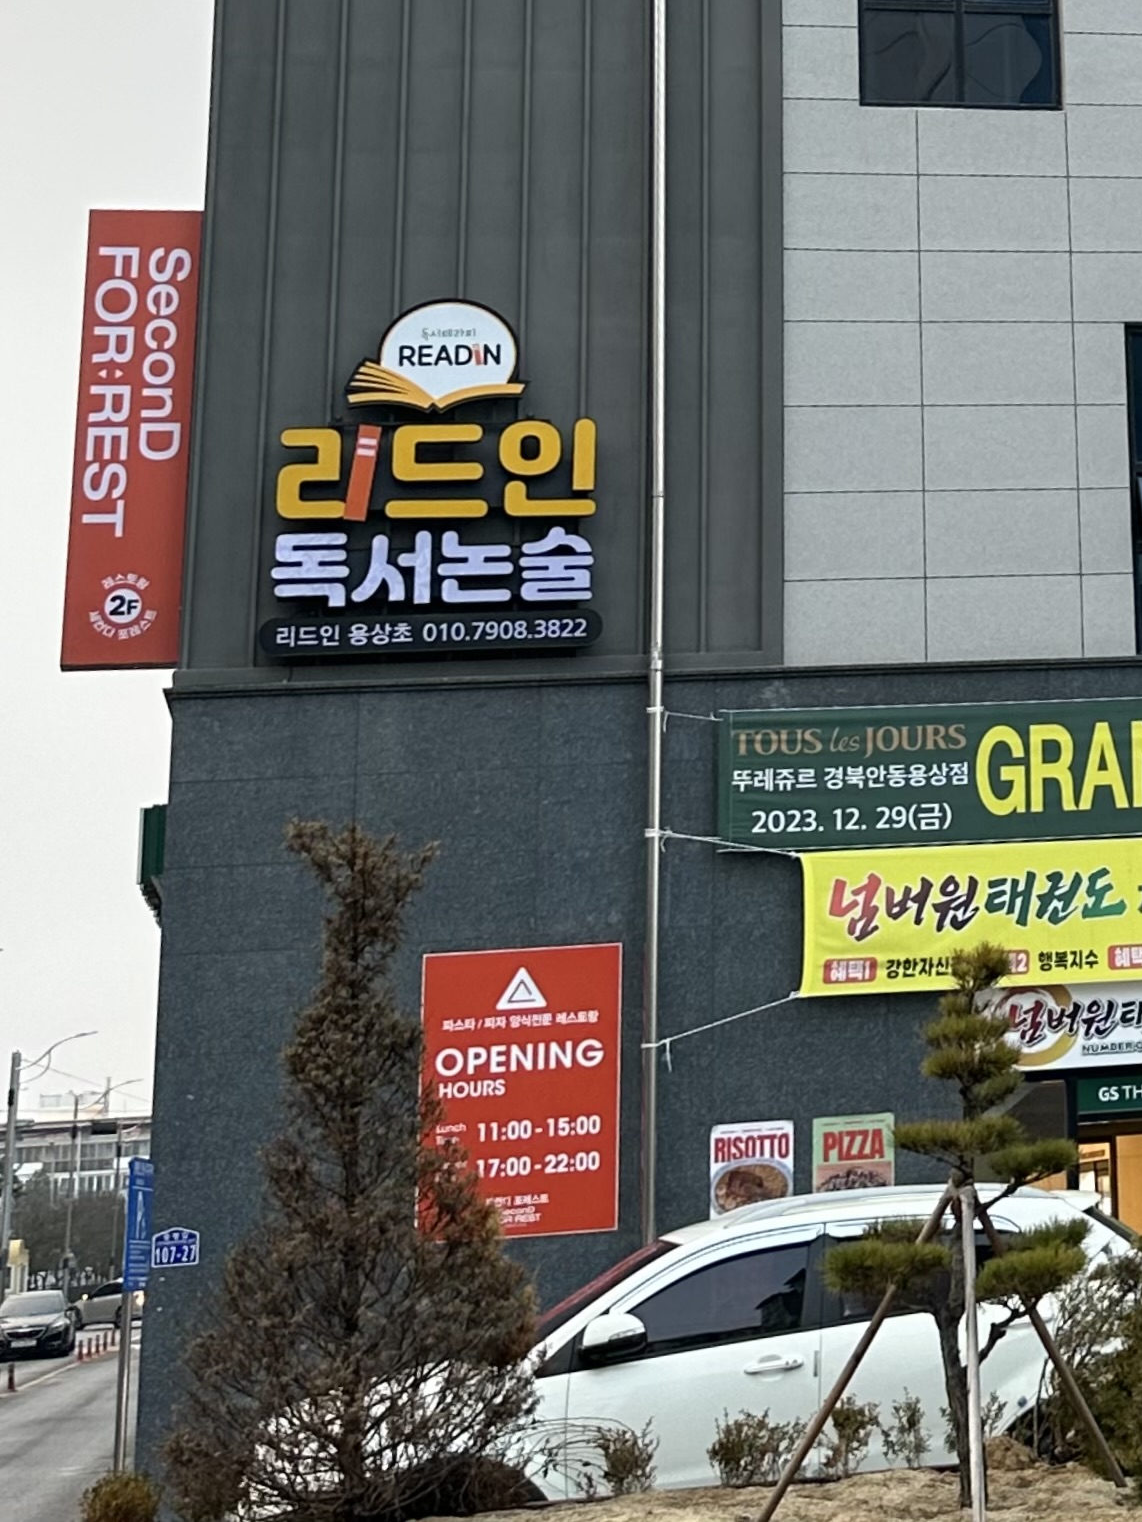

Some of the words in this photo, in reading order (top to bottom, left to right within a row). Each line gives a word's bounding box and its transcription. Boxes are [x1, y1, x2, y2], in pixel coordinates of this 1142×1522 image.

[138, 246, 192, 461] SeconD
[275, 418, 597, 522] 리드인
[270, 526, 594, 607] 독서논술
[109, 594, 139, 616] 2F
[276, 624, 340, 647] 리드인
[348, 622, 413, 646] 용상초
[422, 618, 588, 642] 010.7908.3822
[733, 727, 823, 757] TOUS
[830, 726, 860, 753] les
[864, 723, 967, 759] JOURS
[731, 767, 818, 792] 뚜레쥬르
[824, 762, 969, 790] 경북안동용상점
[751, 808, 824, 833] 2023.
[833, 807, 867, 831] 12.
[875, 803, 953, 831] 29(금)
[885, 956, 952, 979] 강한자신
[1038, 949, 1099, 971] 행복지수
[442, 1019, 475, 1032] 파스타
[484, 1017, 506, 1029] 피자
[509, 1013, 553, 1028] 양식전문
[435, 1038, 604, 1077] OPENING
[438, 1079, 506, 1099] HOURS
[1098, 1086, 1120, 1101] GS
[714, 1133, 790, 1163] RISOTTO
[823, 1128, 885, 1162] PIZZA
[155, 1245, 197, 1264] 107-27
